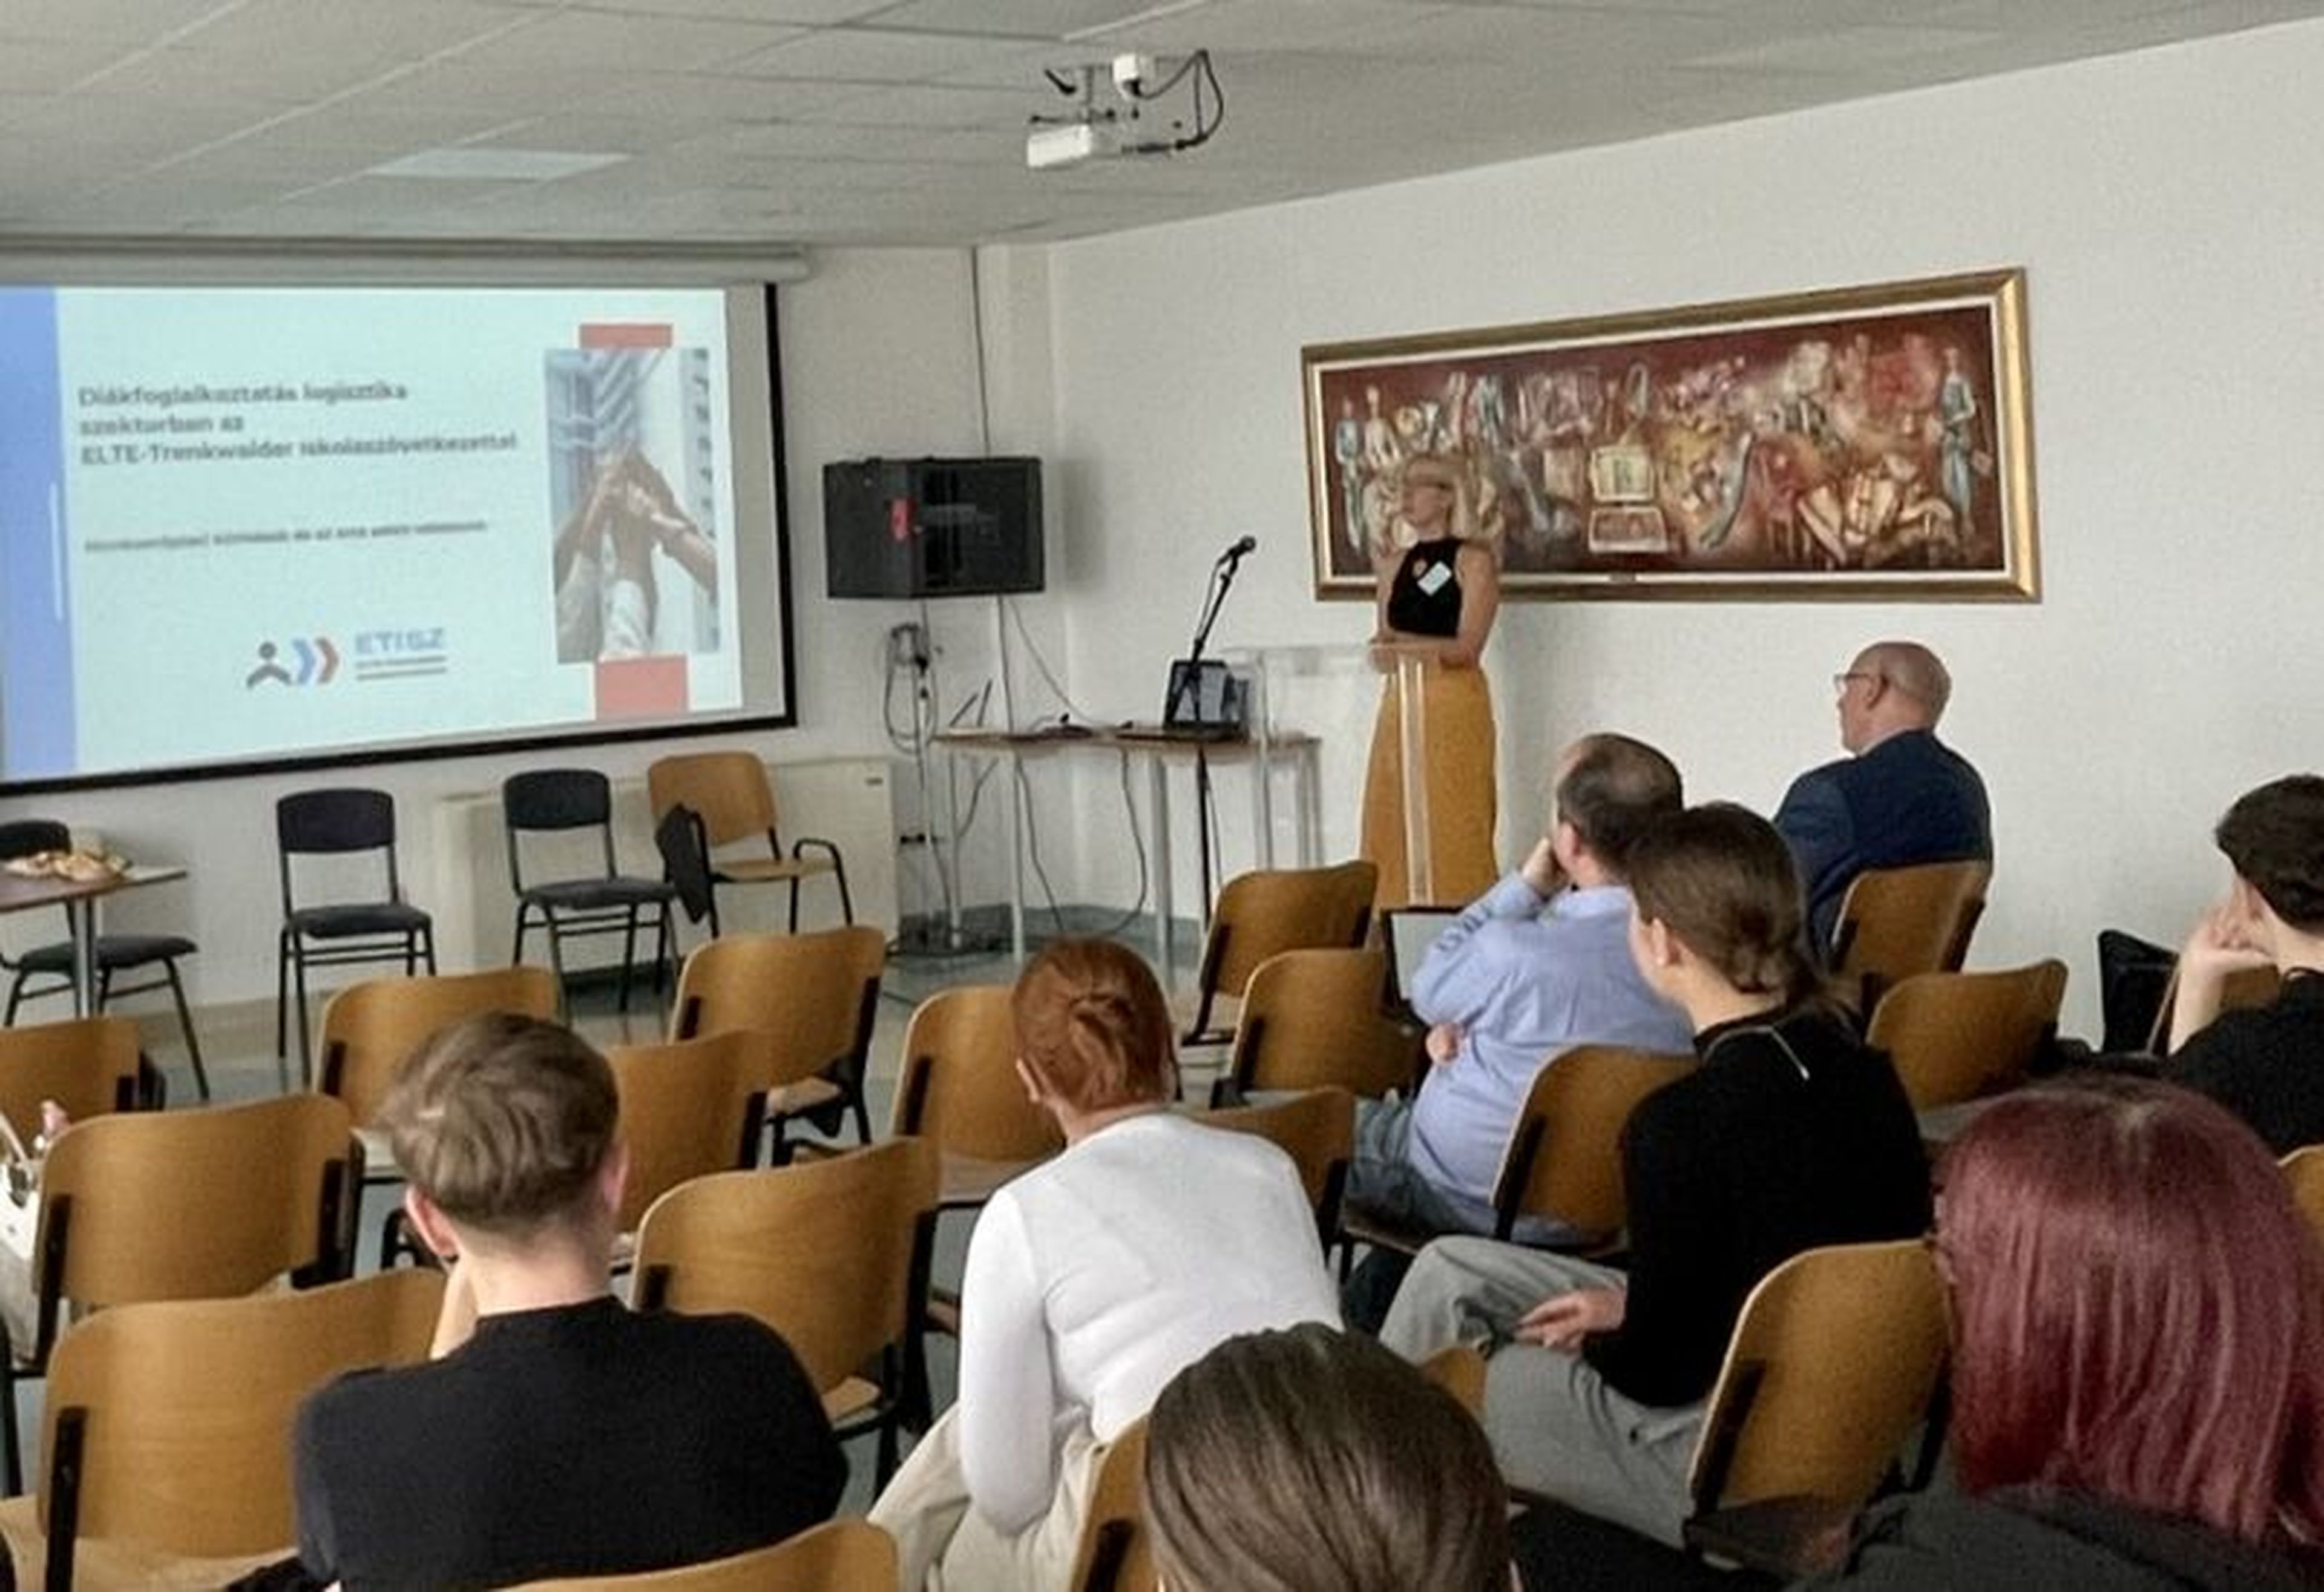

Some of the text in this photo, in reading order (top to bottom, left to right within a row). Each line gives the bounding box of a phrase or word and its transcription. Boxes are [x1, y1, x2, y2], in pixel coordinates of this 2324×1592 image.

[303, 380, 407, 404] logisztika
[79, 414, 244, 436] szektorban az
[80, 439, 292, 465] ELTE-Trenkwalder
